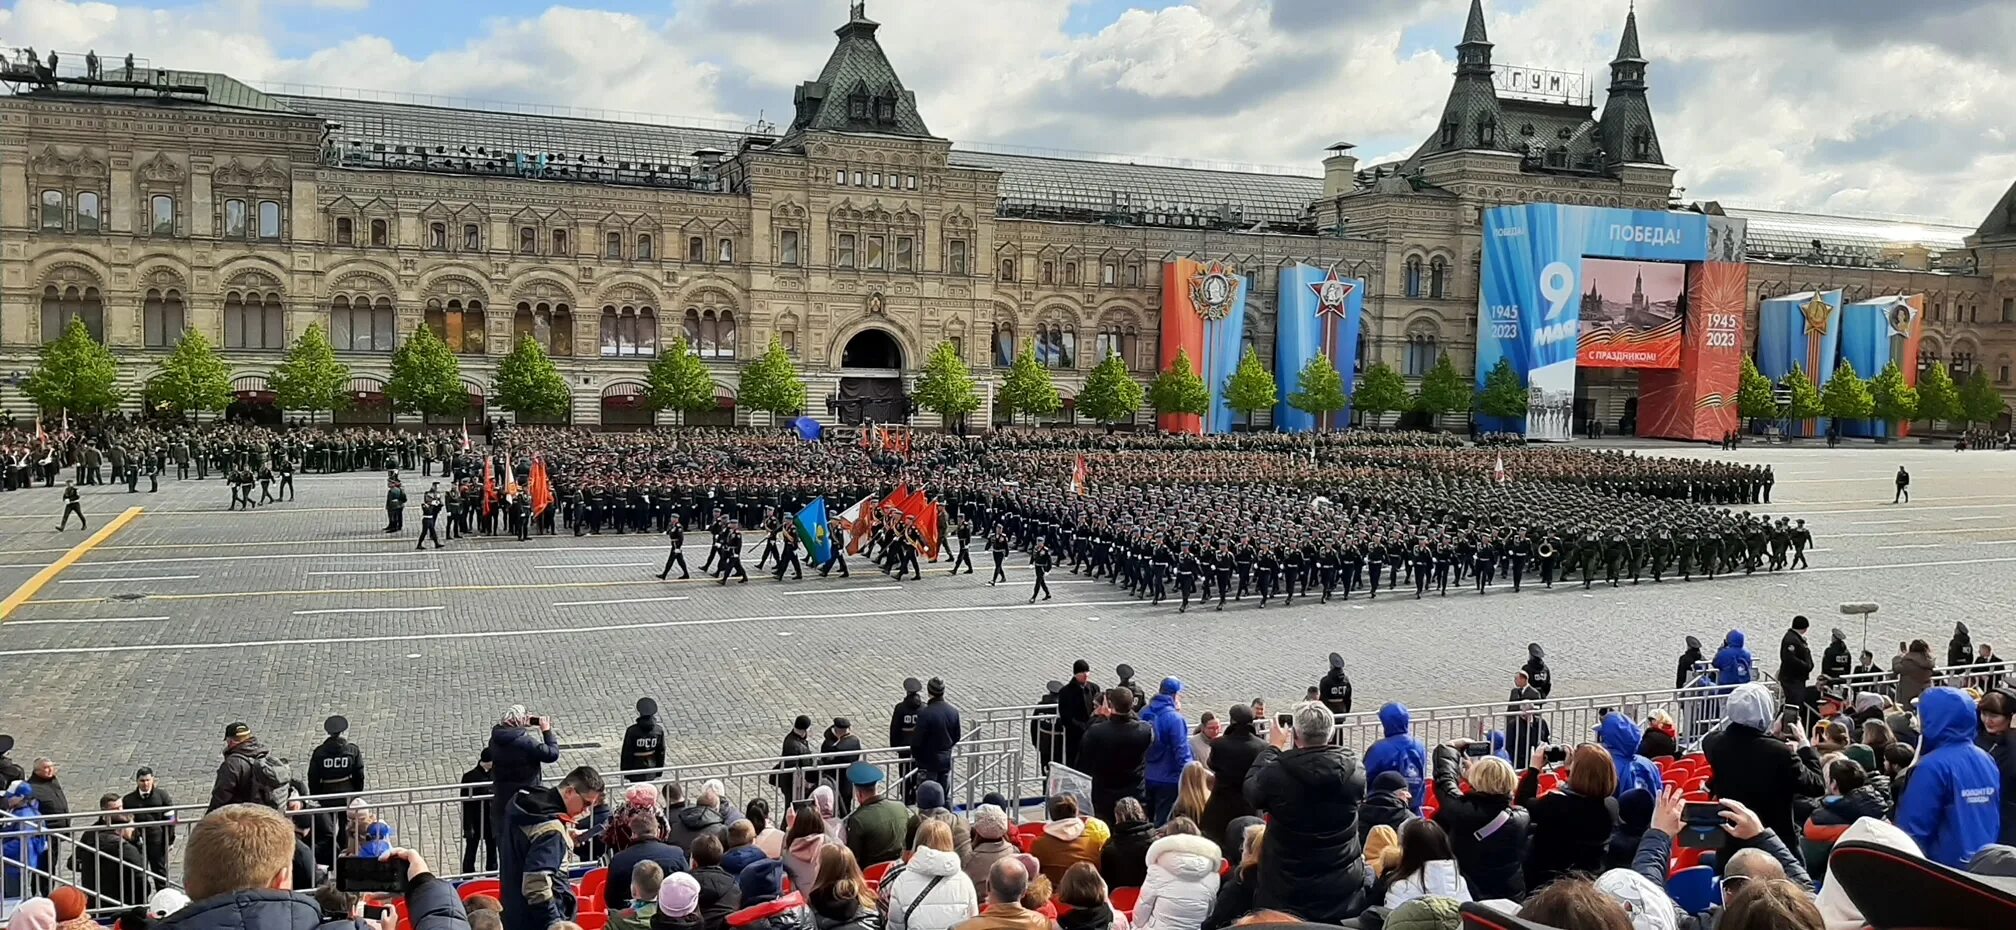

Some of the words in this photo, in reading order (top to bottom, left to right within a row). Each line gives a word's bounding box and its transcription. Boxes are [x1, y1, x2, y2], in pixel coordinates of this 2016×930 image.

[1512, 72, 1560, 91] ГУМ
[1609, 224, 1680, 246] ПОБЕДА!
[1540, 261, 1575, 320] 9
[1491, 304, 1518, 319] 1945
[1707, 314, 1736, 328] 1945
[1491, 324, 1517, 338] 2023
[1534, 319, 1578, 347] МАЯ
[1706, 333, 1735, 347] 2023
[1588, 351, 1596, 359] С
[1596, 350, 1657, 362] ПРАЗДНИКОМ!
[636, 738, 657, 748] ФСО
[323, 757, 349, 768] ФСО
